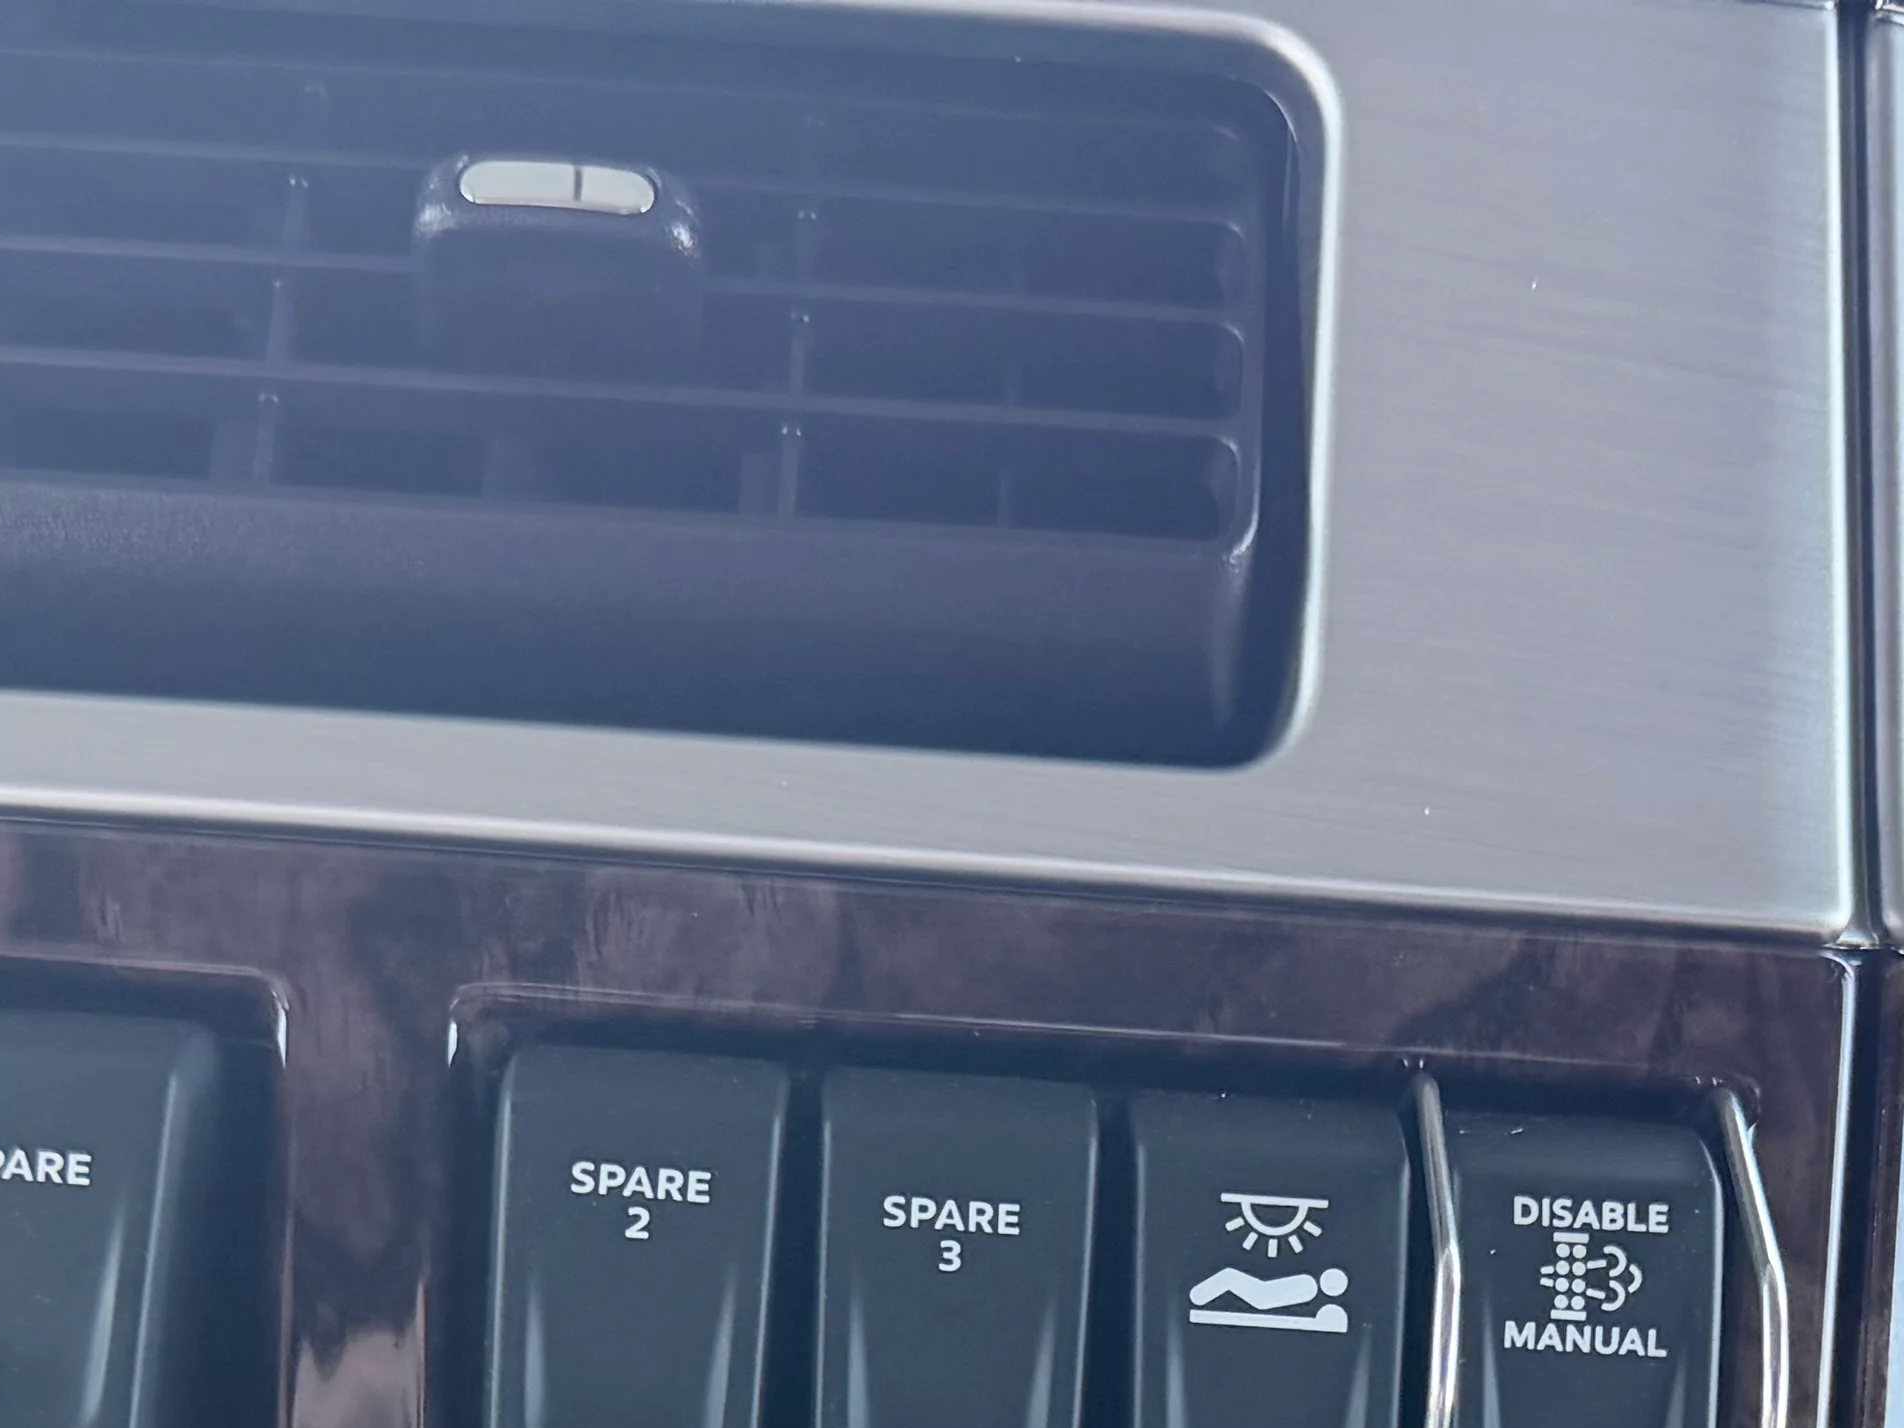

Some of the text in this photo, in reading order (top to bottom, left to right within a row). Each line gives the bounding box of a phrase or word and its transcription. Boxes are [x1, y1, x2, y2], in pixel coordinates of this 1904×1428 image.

[569, 1160, 712, 1205] SPARE
[623, 1205, 652, 1241] 2
[882, 1194, 1021, 1237] SPARE
[1513, 1195, 1670, 1234] DISABLE
[937, 1239, 963, 1273] 3
[1503, 1320, 1668, 1358] MANUAL
